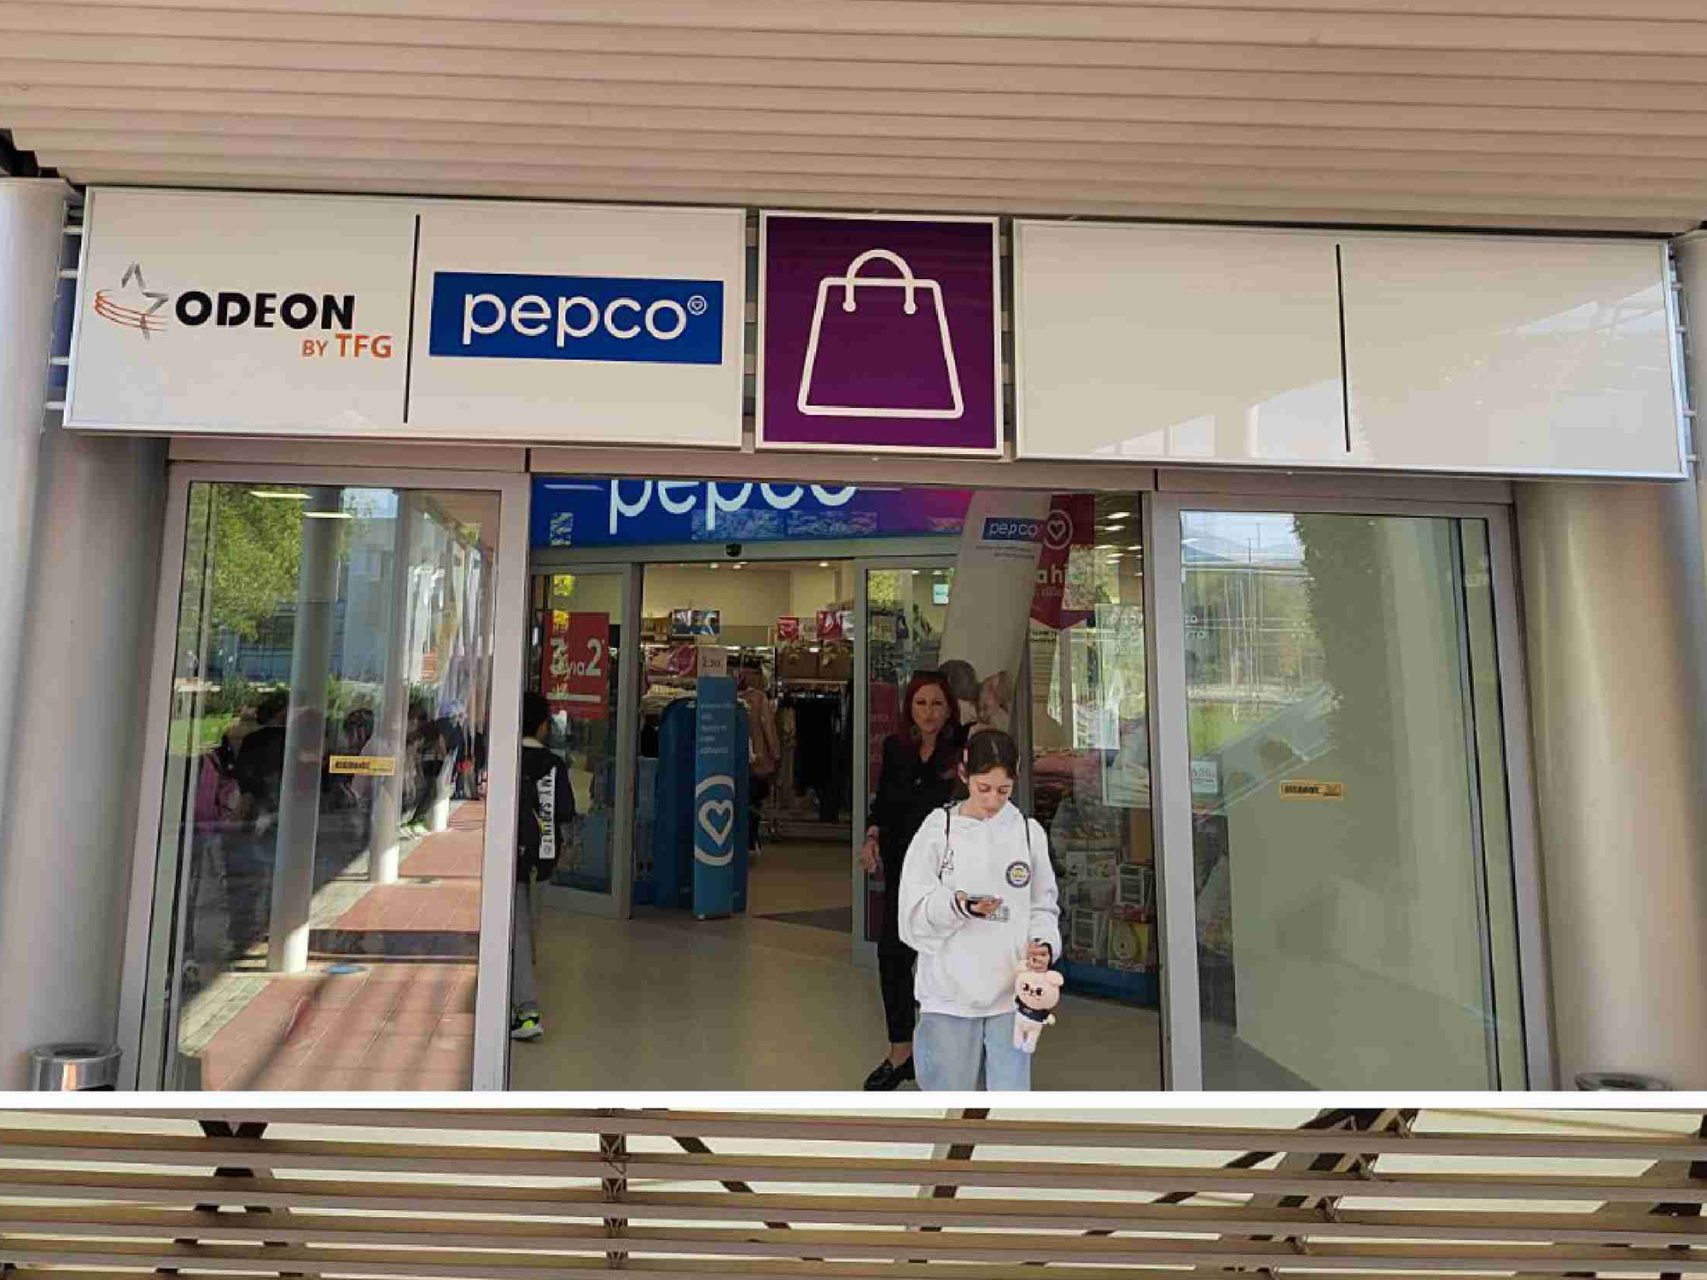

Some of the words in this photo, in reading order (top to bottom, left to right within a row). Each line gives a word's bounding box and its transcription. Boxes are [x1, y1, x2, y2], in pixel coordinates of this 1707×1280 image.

[174, 290, 355, 331] ODEON
[463, 290, 687, 347] pepco
[302, 338, 327, 357] BY
[335, 333, 392, 358] TFG
[989, 521, 1038, 537] pepco
